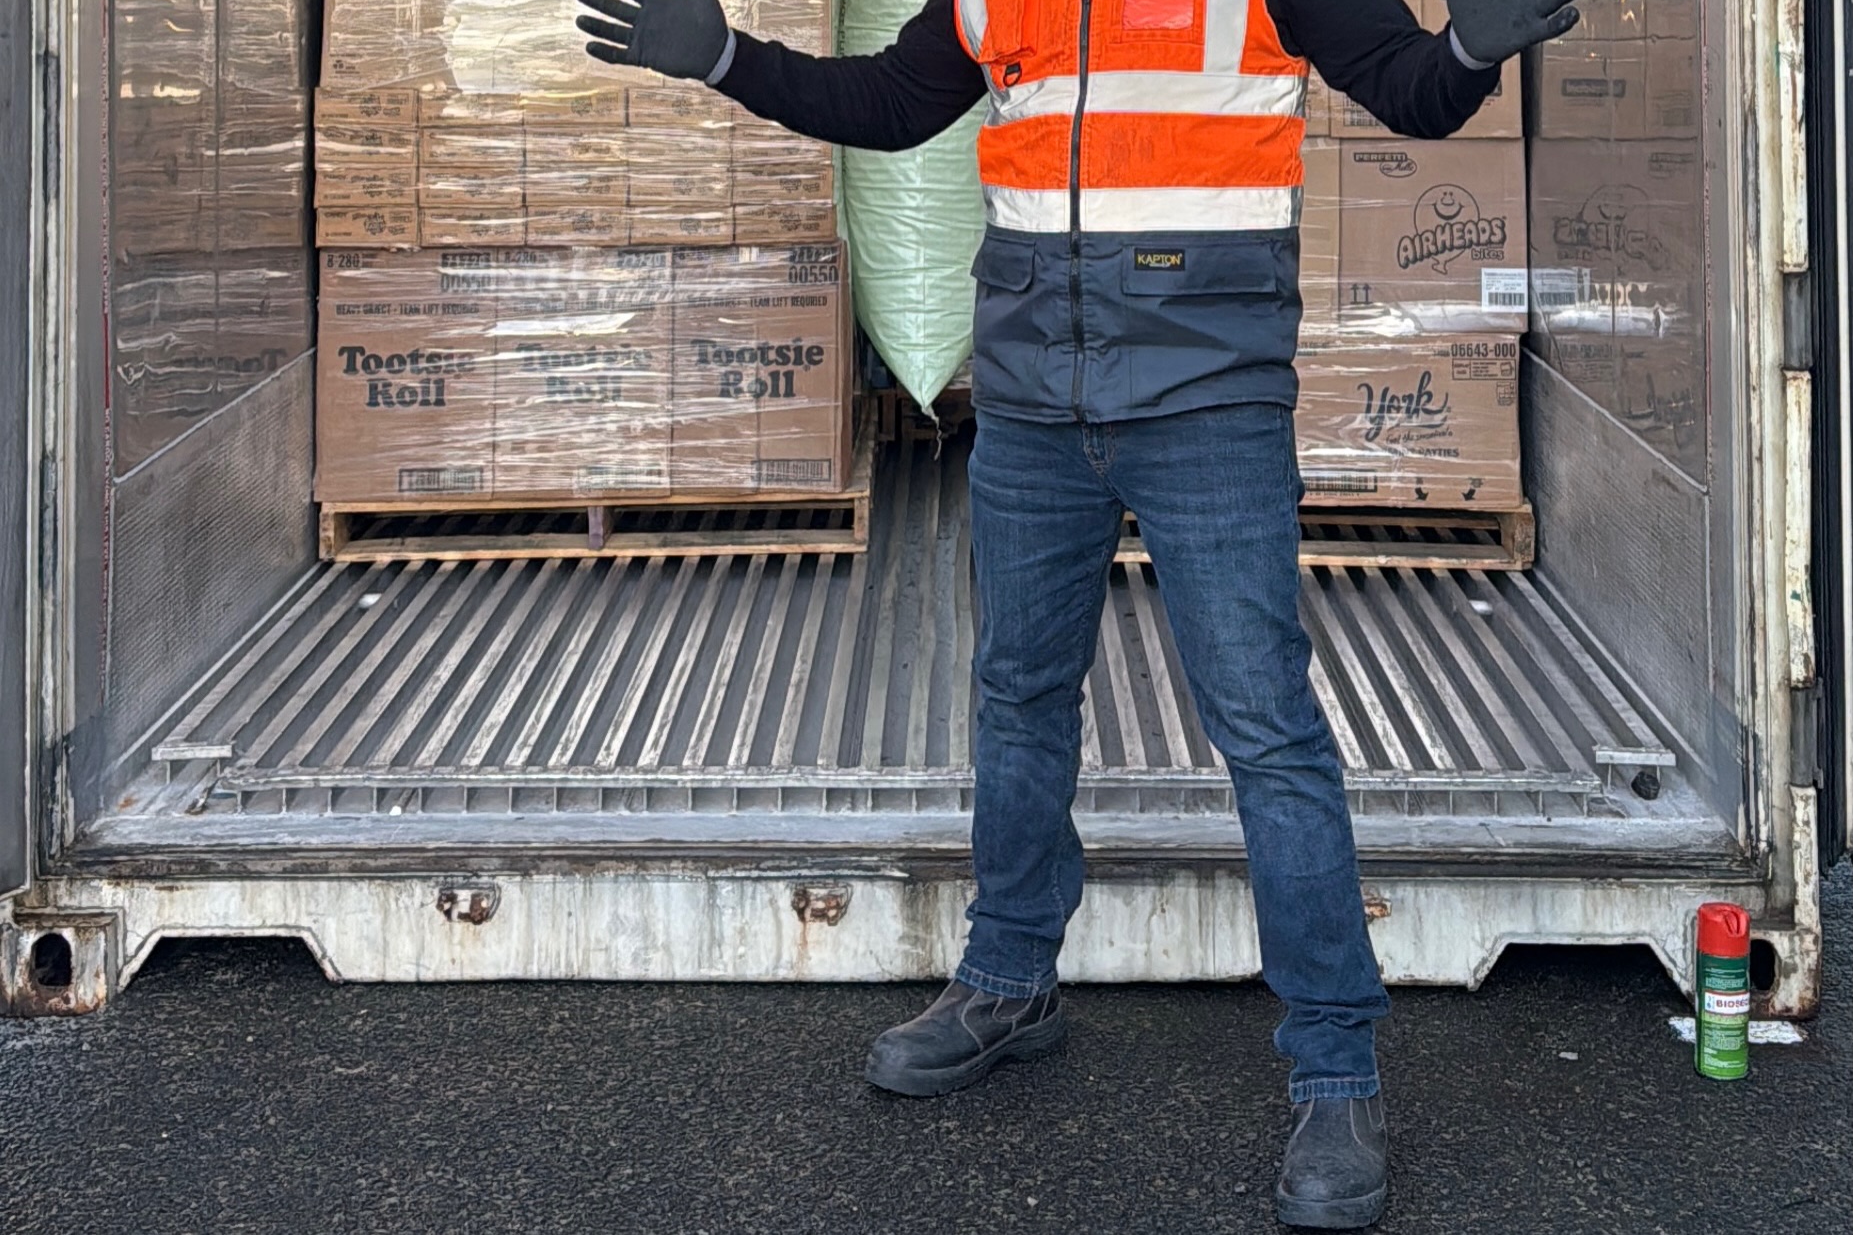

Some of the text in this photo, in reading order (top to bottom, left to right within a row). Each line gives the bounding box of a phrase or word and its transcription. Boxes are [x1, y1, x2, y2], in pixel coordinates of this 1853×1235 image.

[1355, 152, 1407, 162] PERFETTI
[1397, 218, 1507, 269] AIRHEADS
[1137, 253, 1181, 265] KAPTON
[1471, 248, 1504, 261] bites
[788, 265, 839, 283] 00550
[423, 303, 439, 314] LIFT
[749, 297, 770, 308] TEAM
[772, 297, 789, 308] LIFT
[690, 337, 825, 367] Tootsie
[1451, 342, 1517, 358] 06643-000
[338, 345, 477, 376] Tootsie
[365, 377, 447, 408] Roll
[719, 370, 796, 399] Roll
[1357, 370, 1449, 442] York
